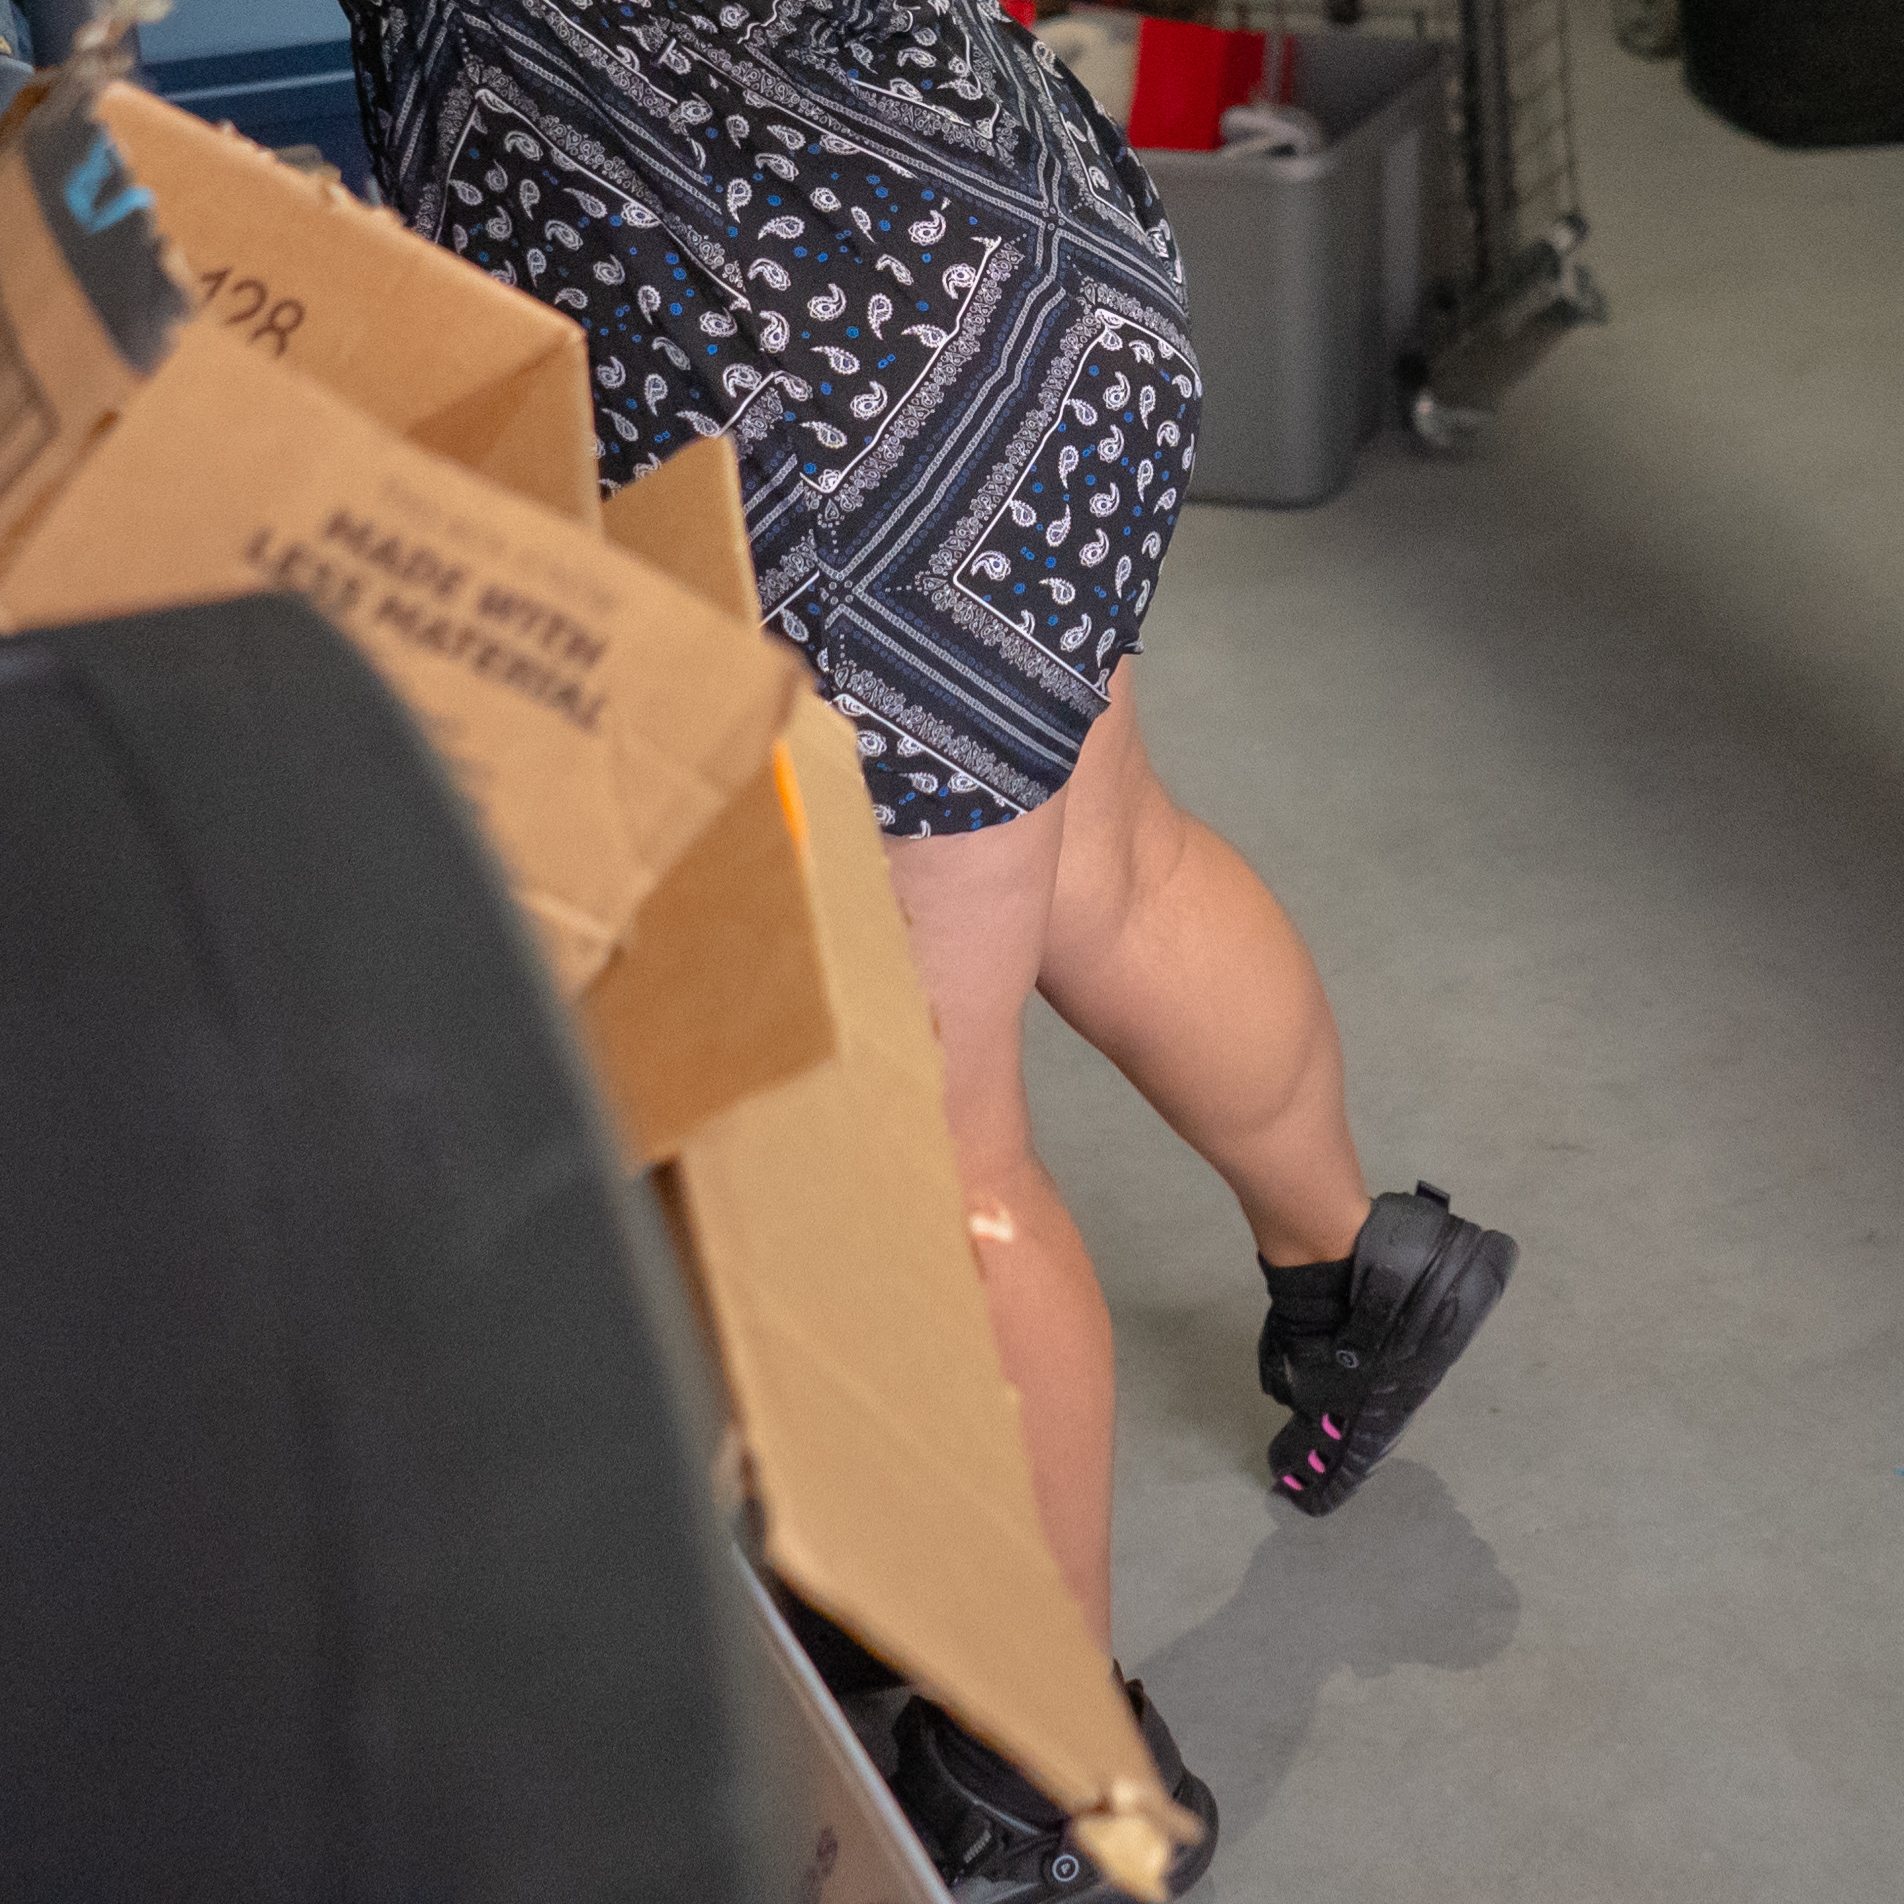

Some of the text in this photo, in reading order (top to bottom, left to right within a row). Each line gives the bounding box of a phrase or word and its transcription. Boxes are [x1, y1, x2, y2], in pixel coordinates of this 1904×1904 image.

[326, 507, 467, 598] MADE
[478, 588, 607, 670] WITH
[377, 593, 607, 732] MATERIAL
